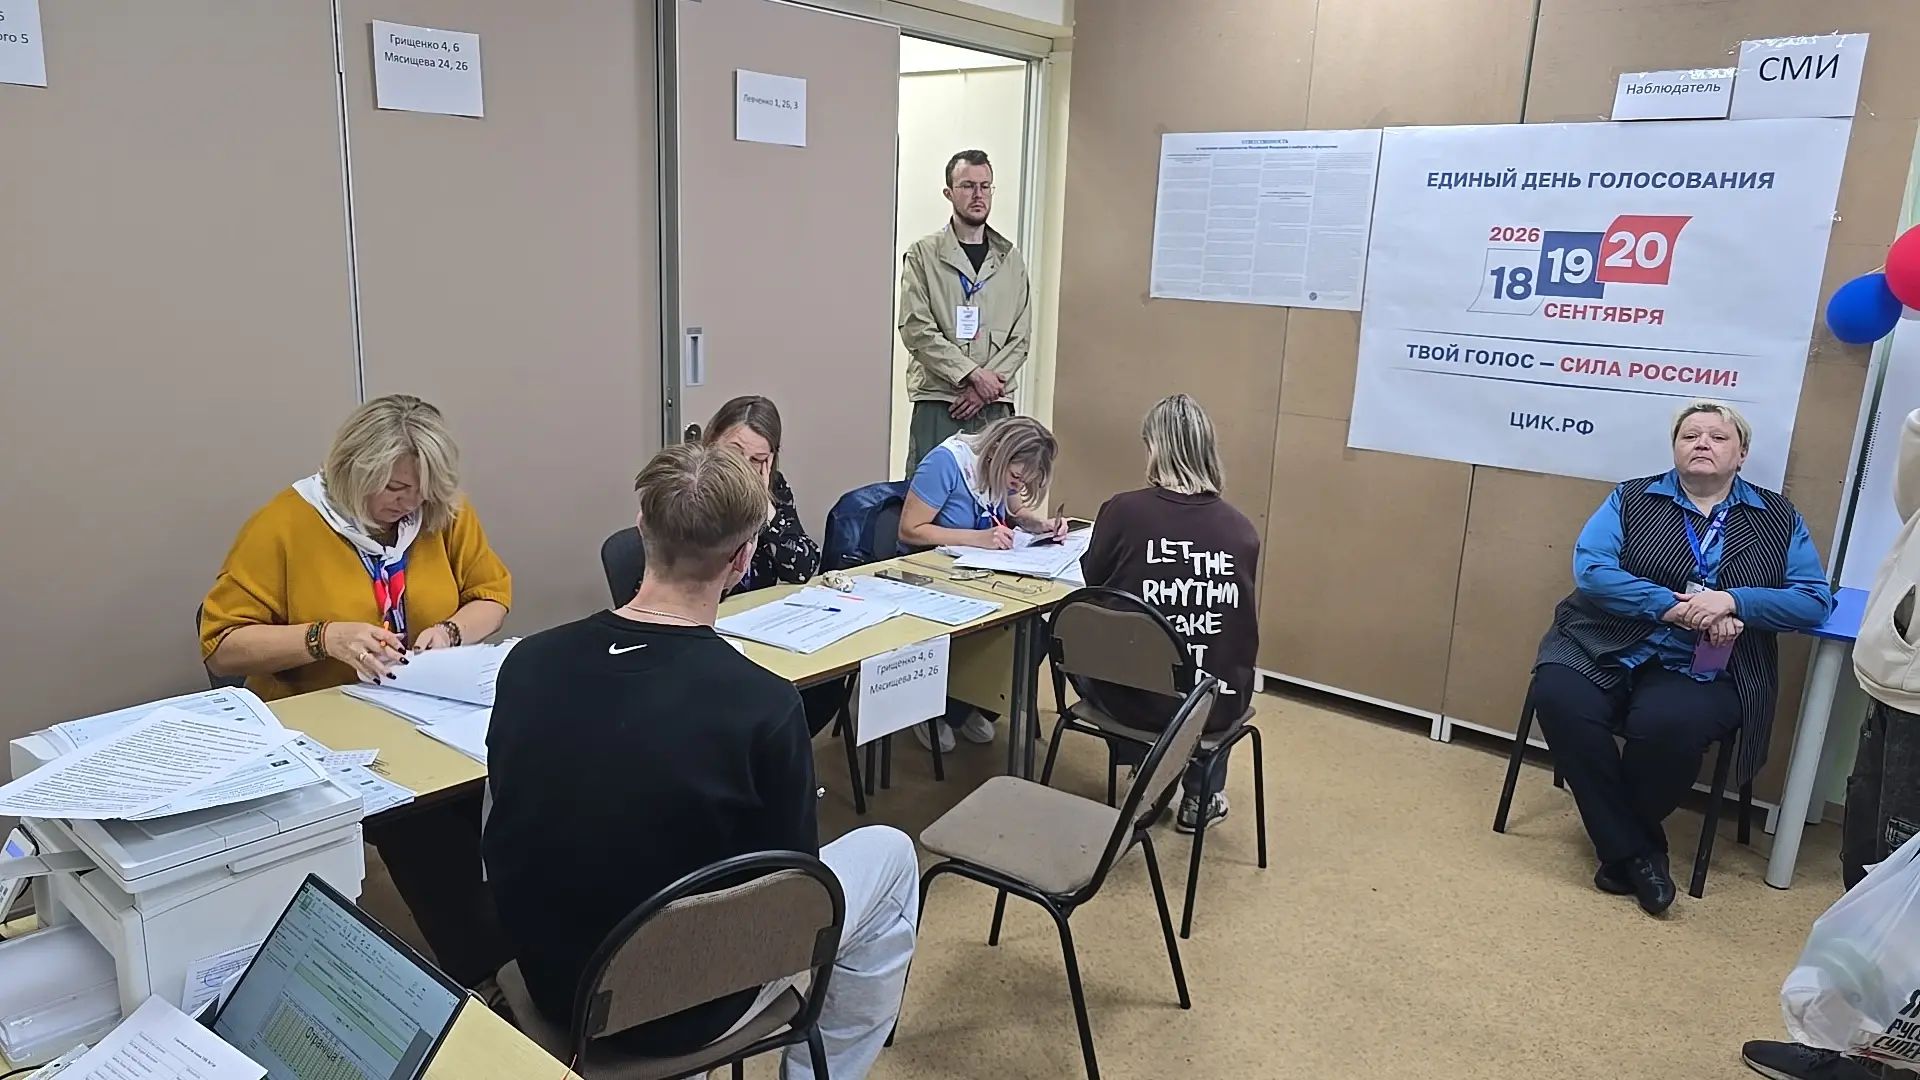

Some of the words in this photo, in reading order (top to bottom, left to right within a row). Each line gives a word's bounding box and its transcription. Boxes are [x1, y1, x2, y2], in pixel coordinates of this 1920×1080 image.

[21, 33, 29, 44] 5
[390, 34, 439, 50] Грищенко
[441, 42, 451, 52] 4,
[453, 43, 460, 52] 6
[385, 52, 436, 68] Мясищева
[438, 59, 453, 70] 24,
[456, 61, 469, 71] 26
[1759, 54, 1840, 81] СМИ
[1626, 82, 1721, 95] Наблюдатель
[1426, 168, 1517, 190] ЕДИНЫЙ
[1521, 172, 1582, 190] ДЕНЬ
[1587, 171, 1775, 189] ГОЛОСОВАНИЯ
[1489, 227, 1540, 243] 2026
[1490, 266, 1533, 301] 18
[1547, 247, 1593, 284] 19
[1604, 231, 1669, 269] 20
[1543, 303, 1665, 325] СЕНТЯБРЯ
[1406, 343, 1459, 362] ТВОЙ
[1465, 349, 1535, 369] ГОЛОС
[1559, 356, 1622, 377] СИЛА
[1628, 362, 1738, 387] РОССИИ!
[1509, 411, 1595, 435] ЦИК.РФ
[1146, 538, 1194, 564] LET
[1189, 551, 1235, 578] THE
[1142, 577, 1239, 609] RHYTHM
[876, 655, 917, 676] Грищенко
[918, 651, 926, 661] 4,
[928, 649, 934, 659] 6
[869, 673, 912, 695] Мясищева
[913, 669, 926, 680] 24,
[928, 665, 939, 676] 26
